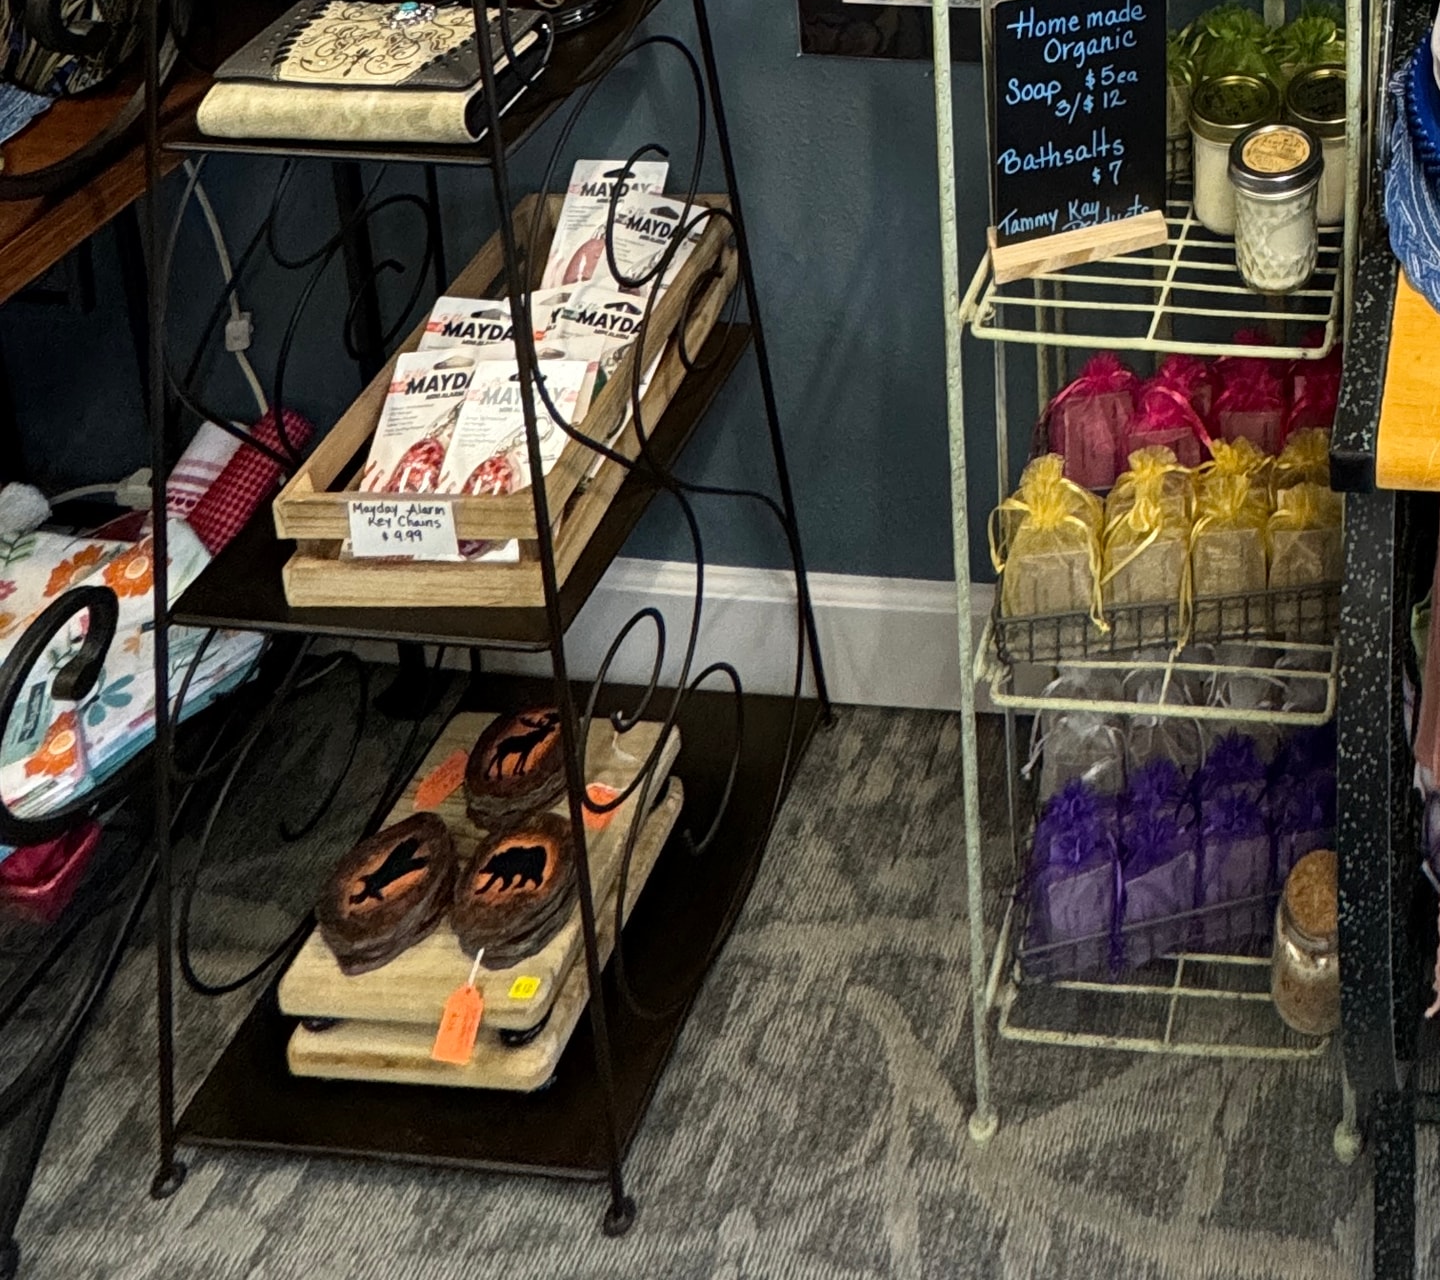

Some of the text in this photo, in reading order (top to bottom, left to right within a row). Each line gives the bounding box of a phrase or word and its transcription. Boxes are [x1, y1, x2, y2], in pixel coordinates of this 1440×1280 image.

[1007, 7, 1080, 39] Home
[1043, 27, 1137, 68] Organic
[1005, 78, 1062, 106] Soap
[997, 127, 1125, 174] Bathsalts
[997, 198, 1100, 236] Tammy Kay
[441, 320, 514, 341] MAYDA
[576, 309, 641, 336] MAYDA
[404, 372, 476, 395] MAYD
[353, 502, 445, 520] Mayday Alarm
[368, 515, 442, 529] Key Chains
